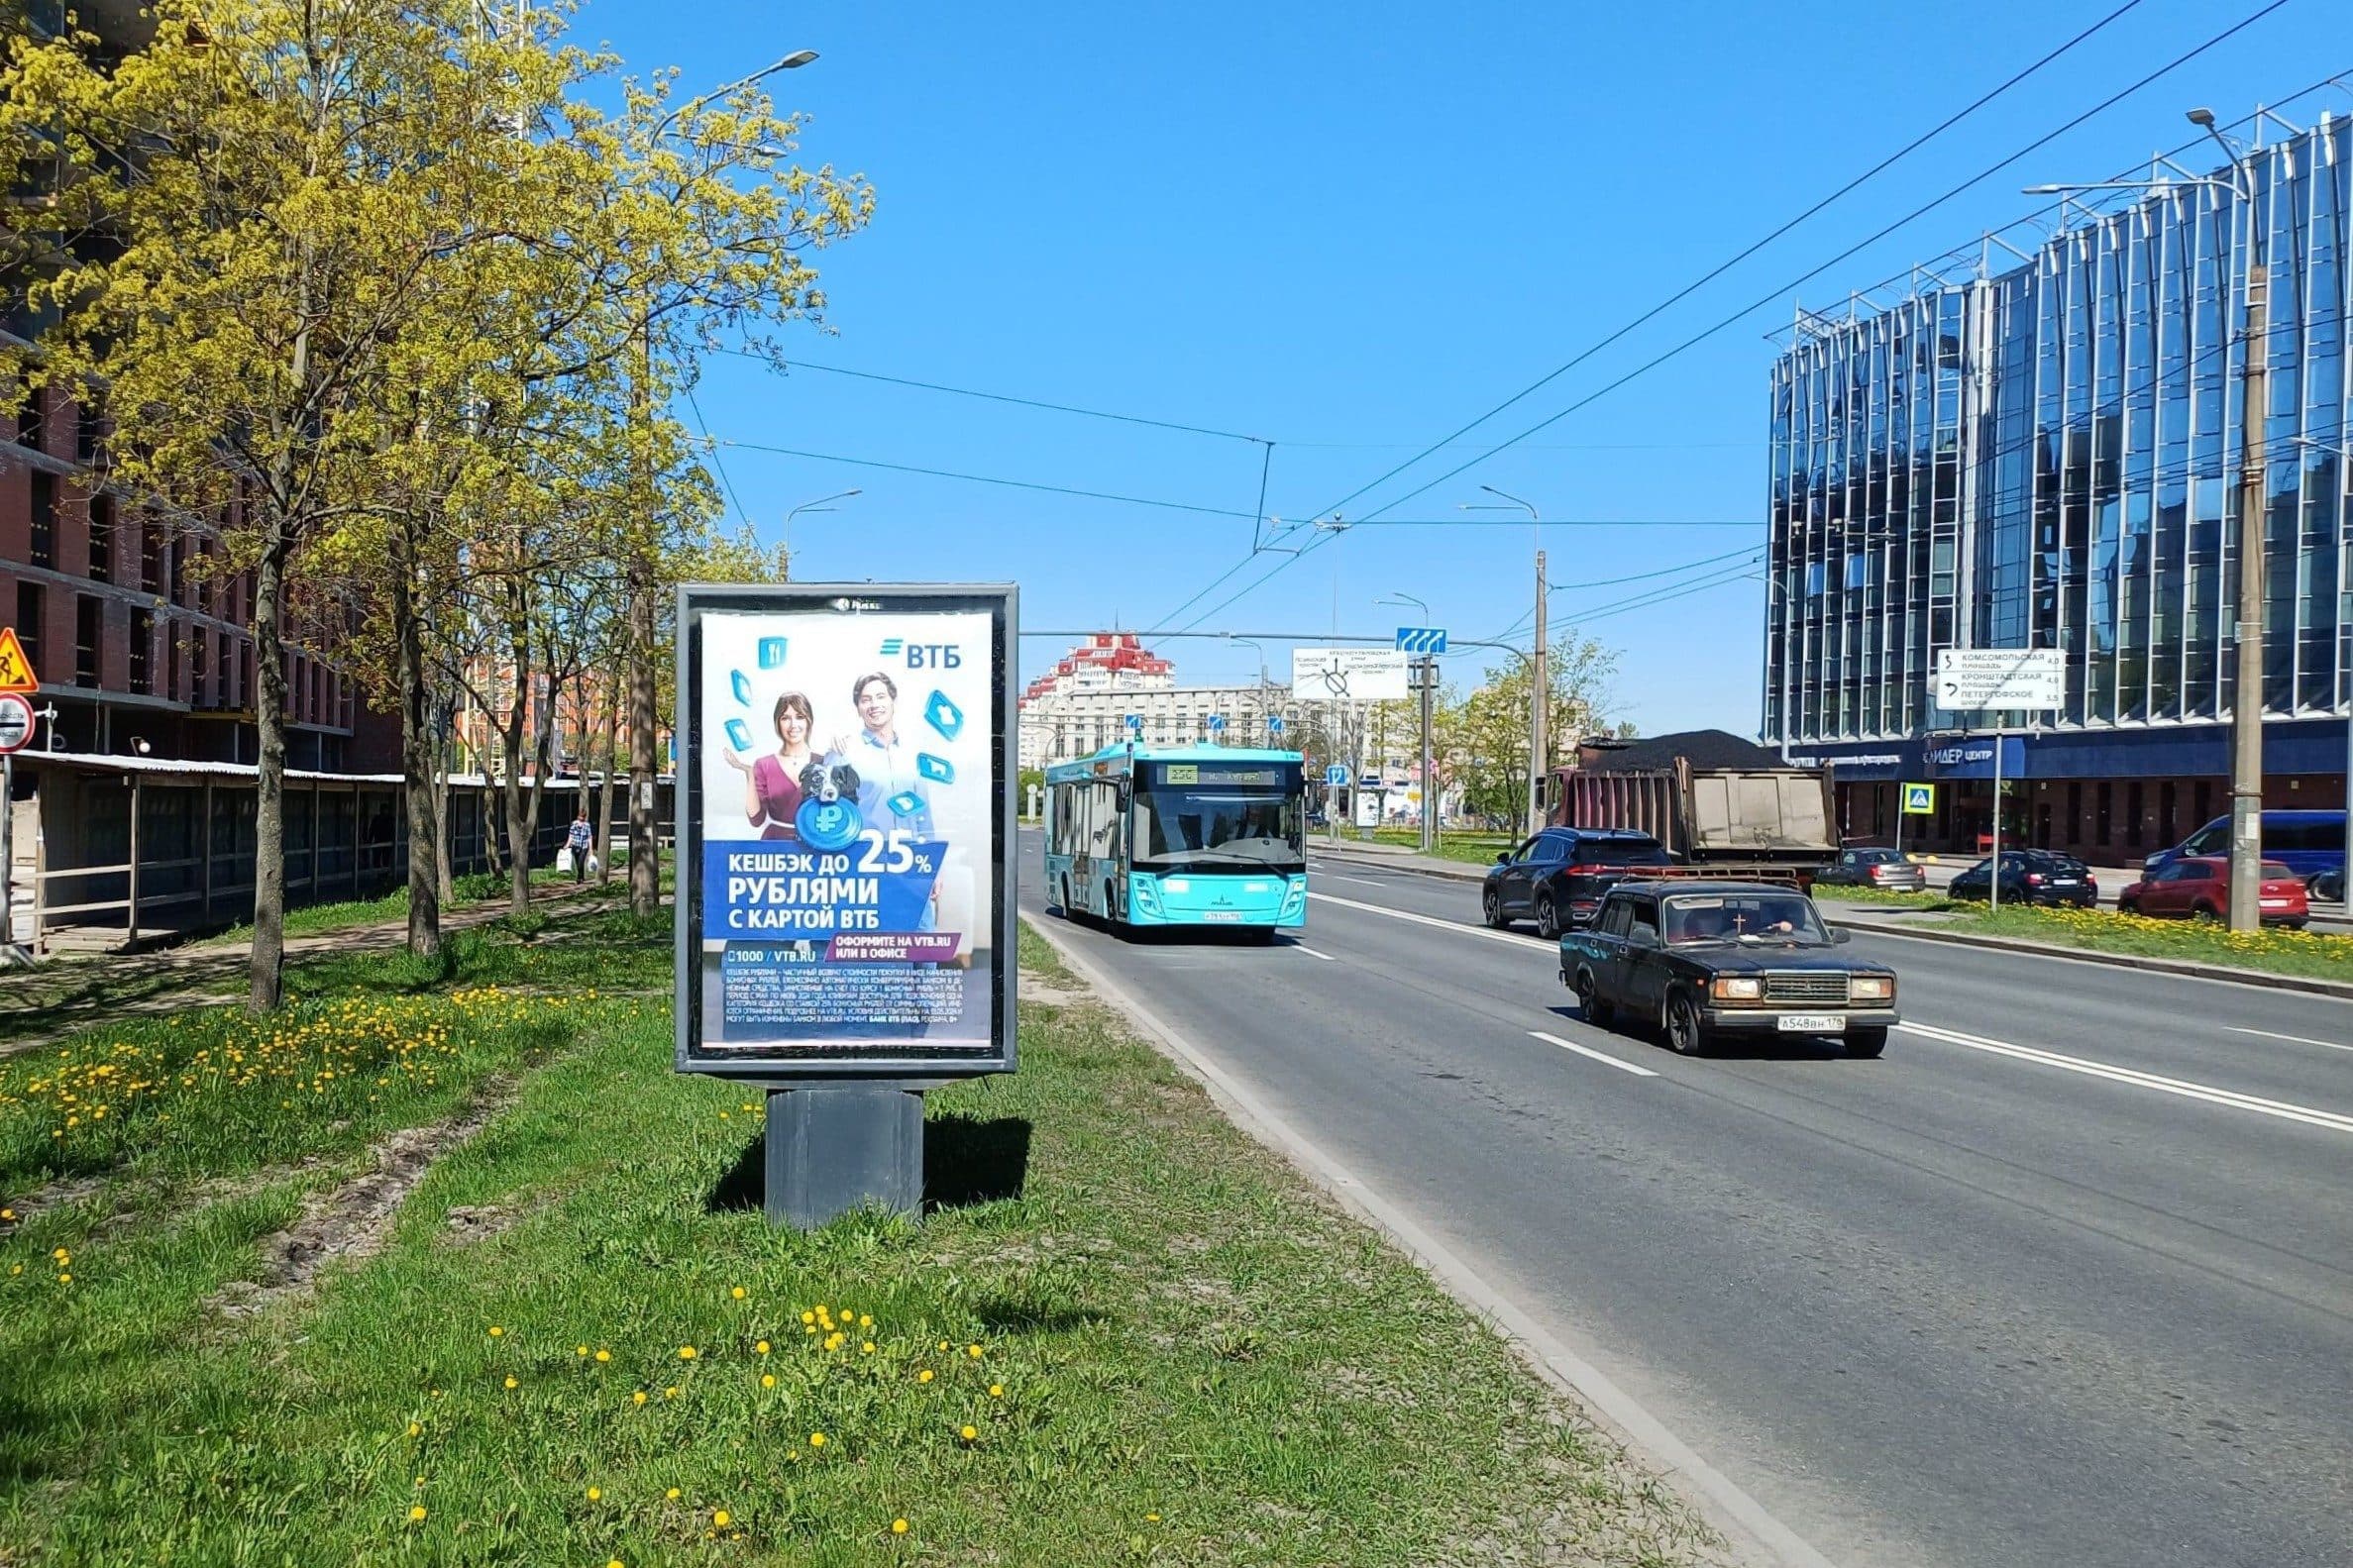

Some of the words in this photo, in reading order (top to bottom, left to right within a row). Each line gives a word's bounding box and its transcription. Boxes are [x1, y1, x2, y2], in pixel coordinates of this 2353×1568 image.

[907, 644, 961, 669] ВТБ
[728, 854, 814, 873] КЕШБЭК
[818, 854, 850, 876] ДО
[857, 828, 932, 874] 25%
[728, 878, 879, 904] РУБЛЯМИ
[728, 909, 743, 929] С
[748, 905, 835, 929] КАРТОЙ
[841, 909, 880, 929] ВТБ
[835, 936, 897, 947] ОФОРМИТЕ
[898, 936, 912, 947] НА
[914, 936, 951, 947] VTB.RU
[835, 948, 859, 959] ИЛИ
[860, 948, 868, 959] В
[869, 948, 908, 959] ОФИСЕ
[736, 950, 764, 962] 1000
[774, 950, 816, 962] VTB.RU
